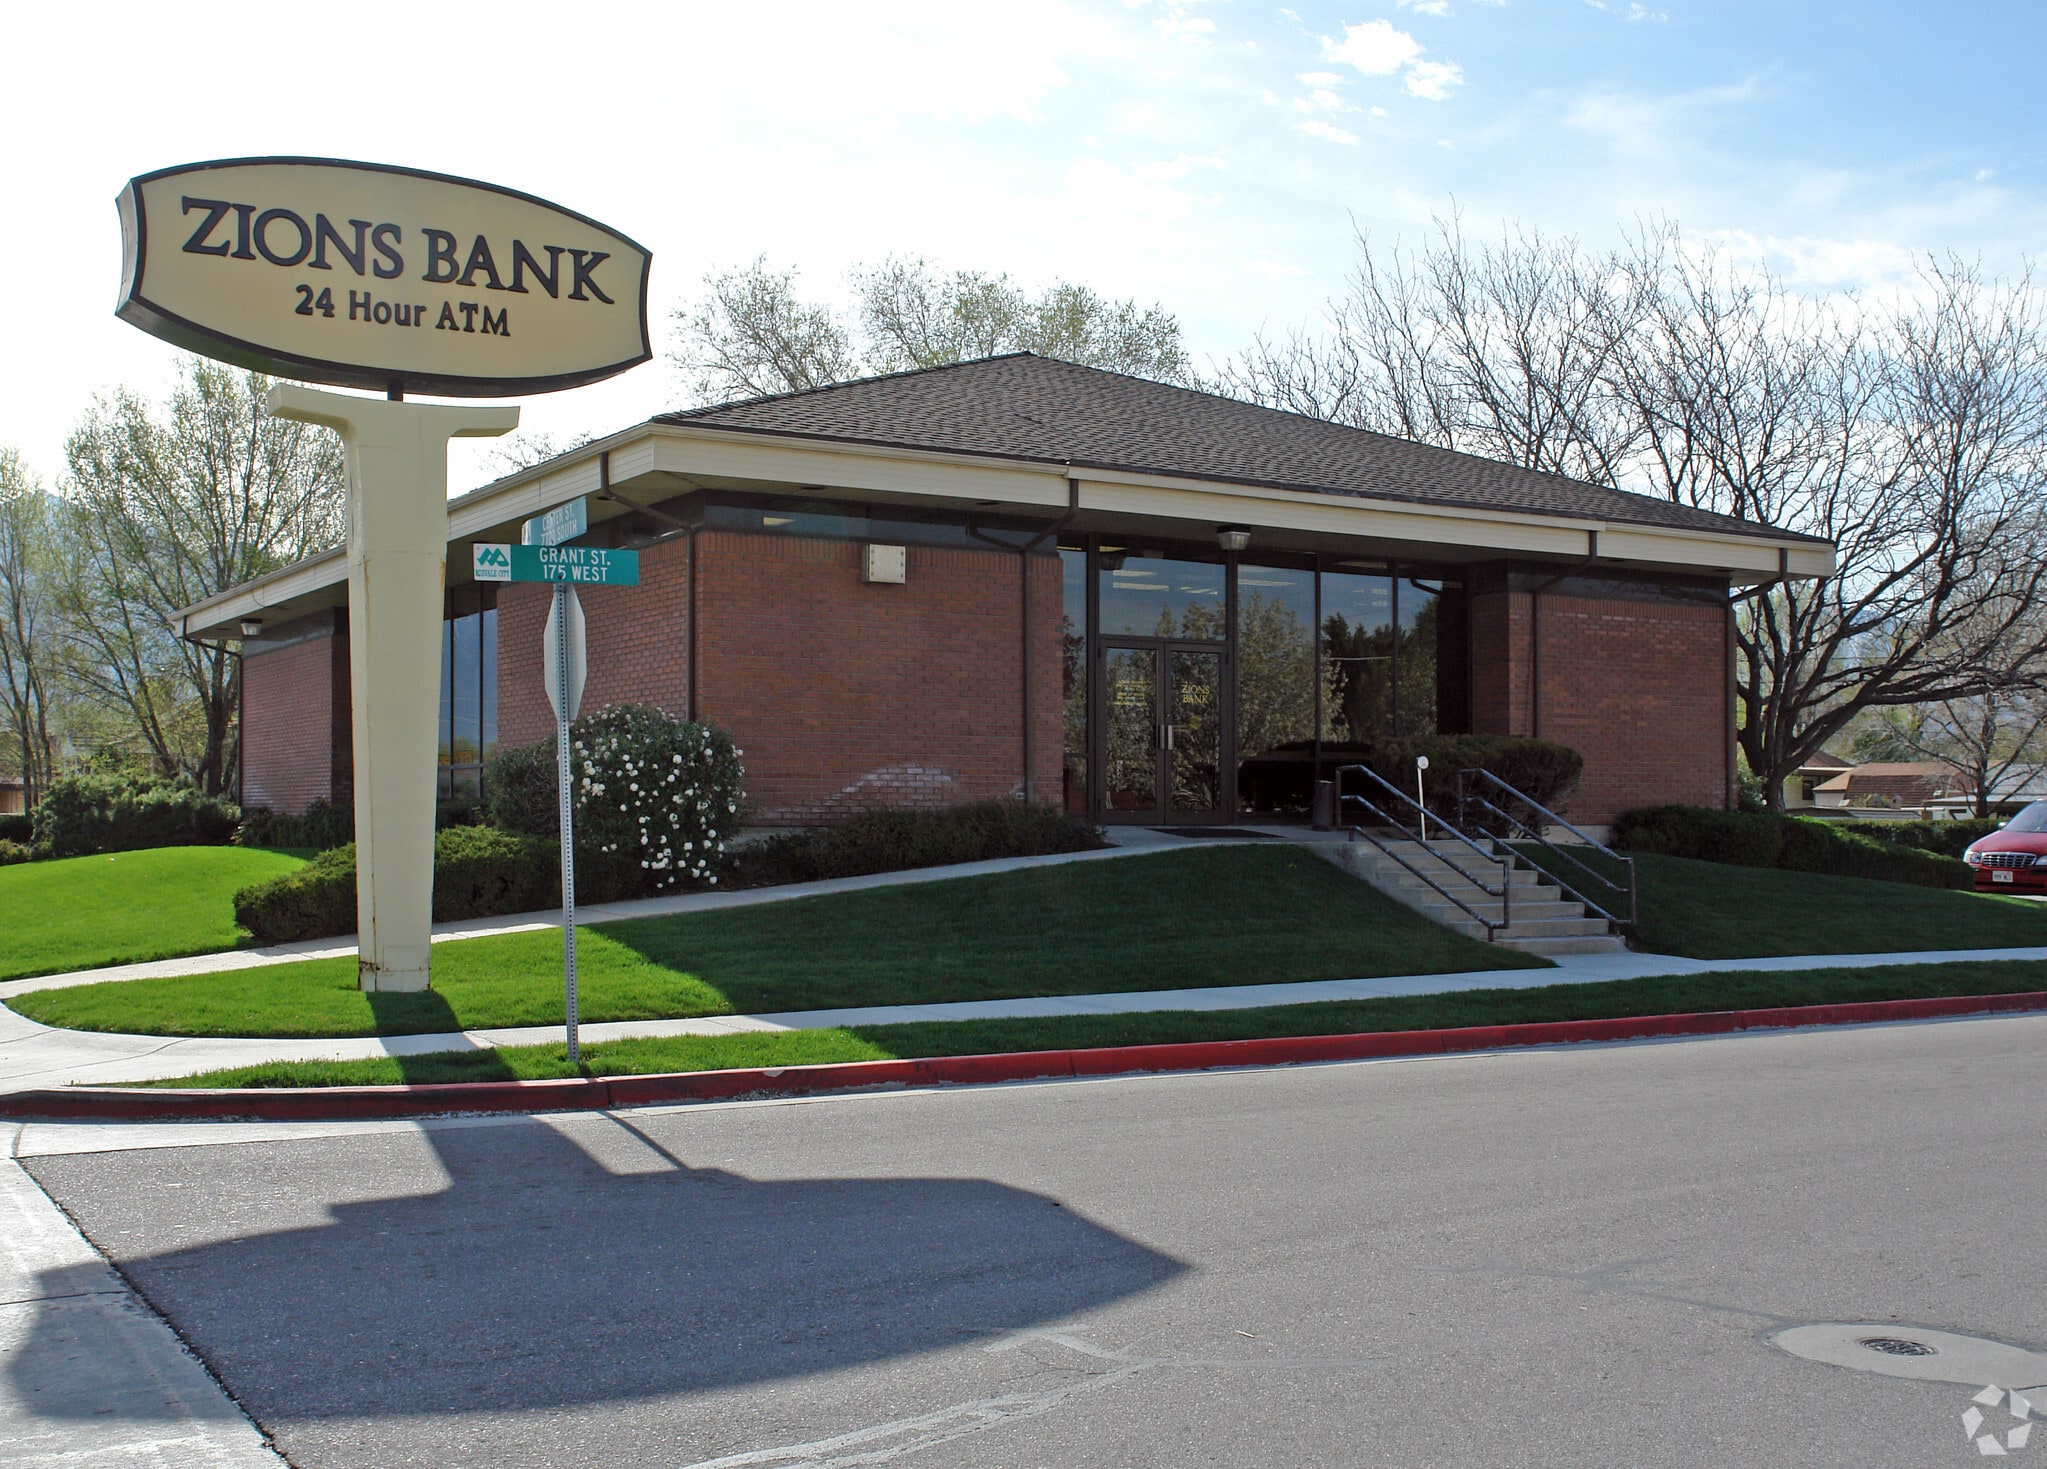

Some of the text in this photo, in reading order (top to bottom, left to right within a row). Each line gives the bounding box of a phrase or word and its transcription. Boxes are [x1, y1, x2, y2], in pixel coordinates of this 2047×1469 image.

[181, 195, 615, 305] ZIONS BANK
[294, 284, 511, 337] 24 Hour ATM
[542, 504, 575, 531] CENTER ST.
[557, 519, 577, 541] SOUTH
[539, 547, 611, 566] GRANT ST.
[543, 565, 608, 582] 175 WEST
[1181, 684, 1210, 694] ZIONS
[1182, 694, 1209, 704] BANK
